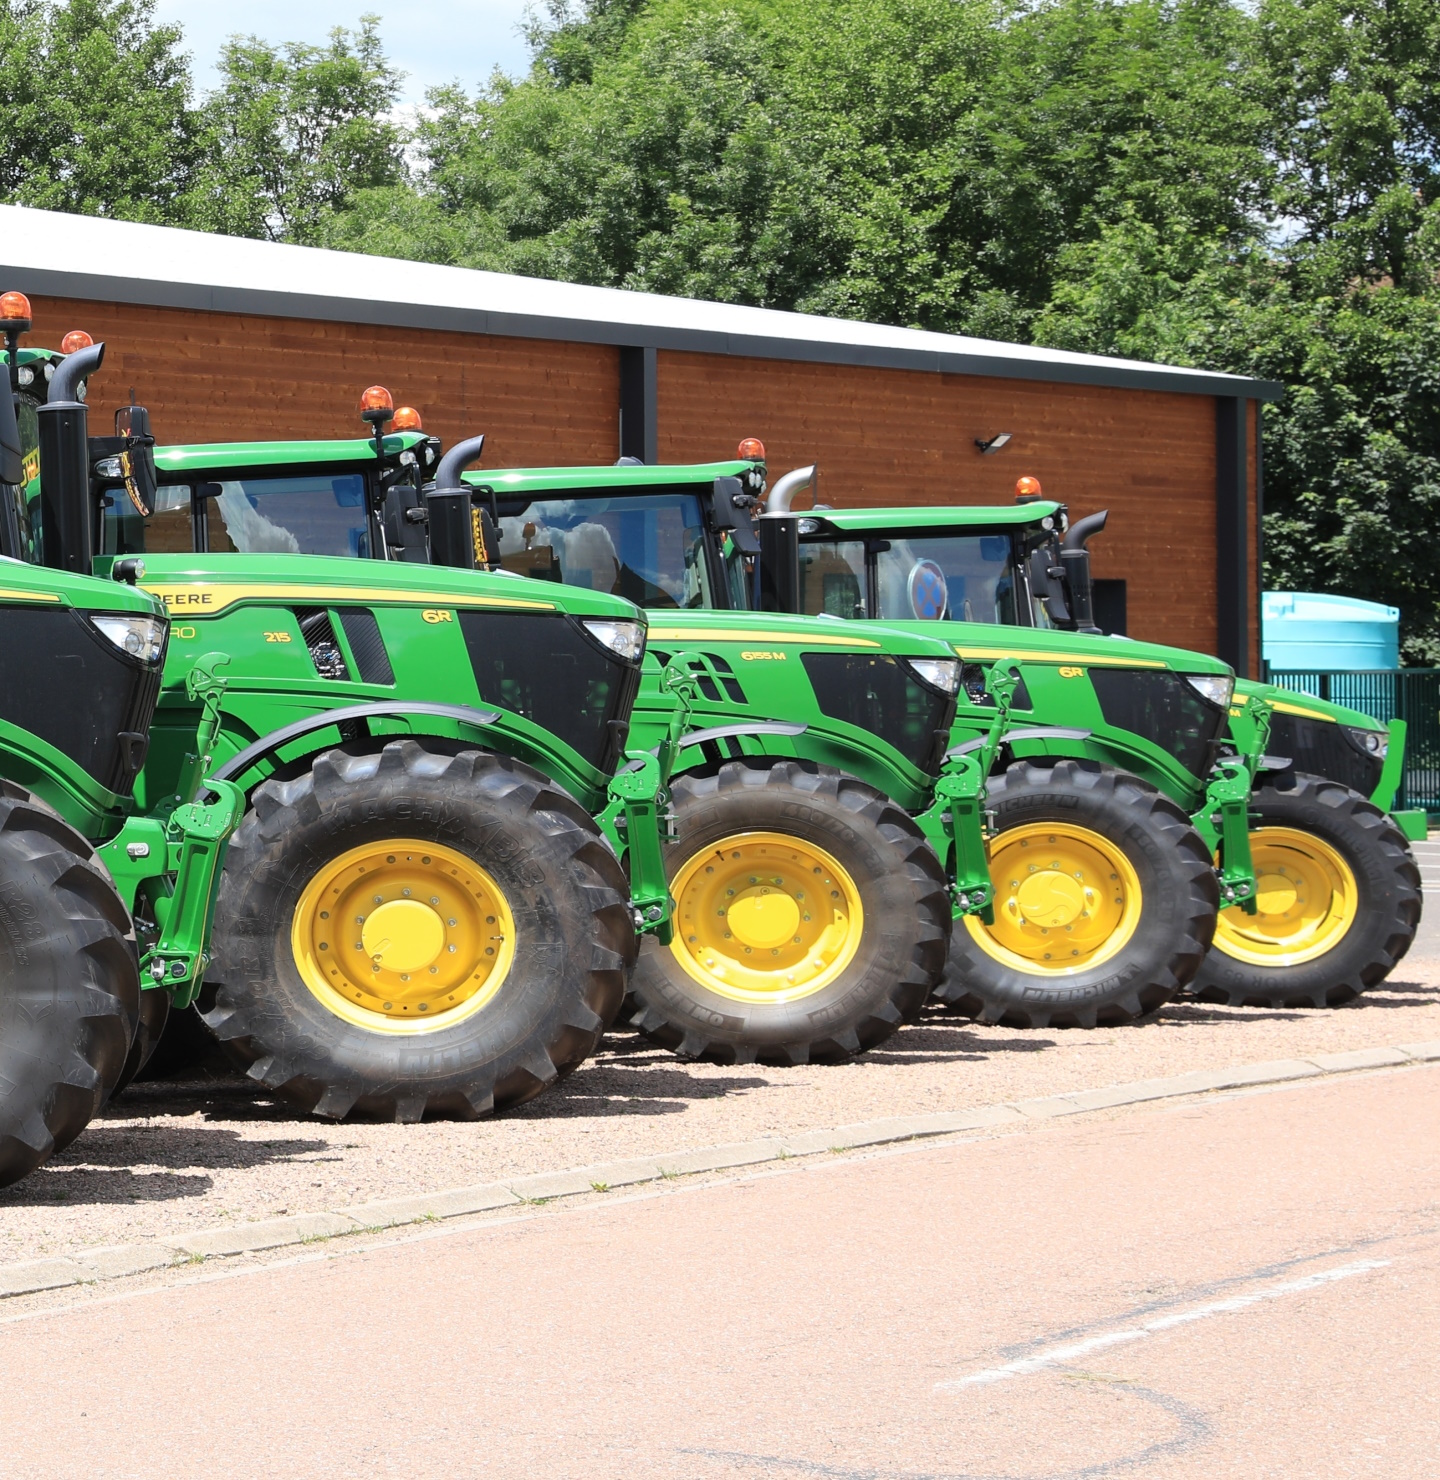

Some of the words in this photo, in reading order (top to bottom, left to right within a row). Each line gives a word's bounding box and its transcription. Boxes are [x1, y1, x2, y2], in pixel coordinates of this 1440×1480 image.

[421, 608, 453, 624] 6R
[263, 632, 292, 643] 215
[1059, 667, 1084, 678] 6R
[1220, 967, 1245, 984] 85
[1023, 977, 1122, 1000] MICHELIN
